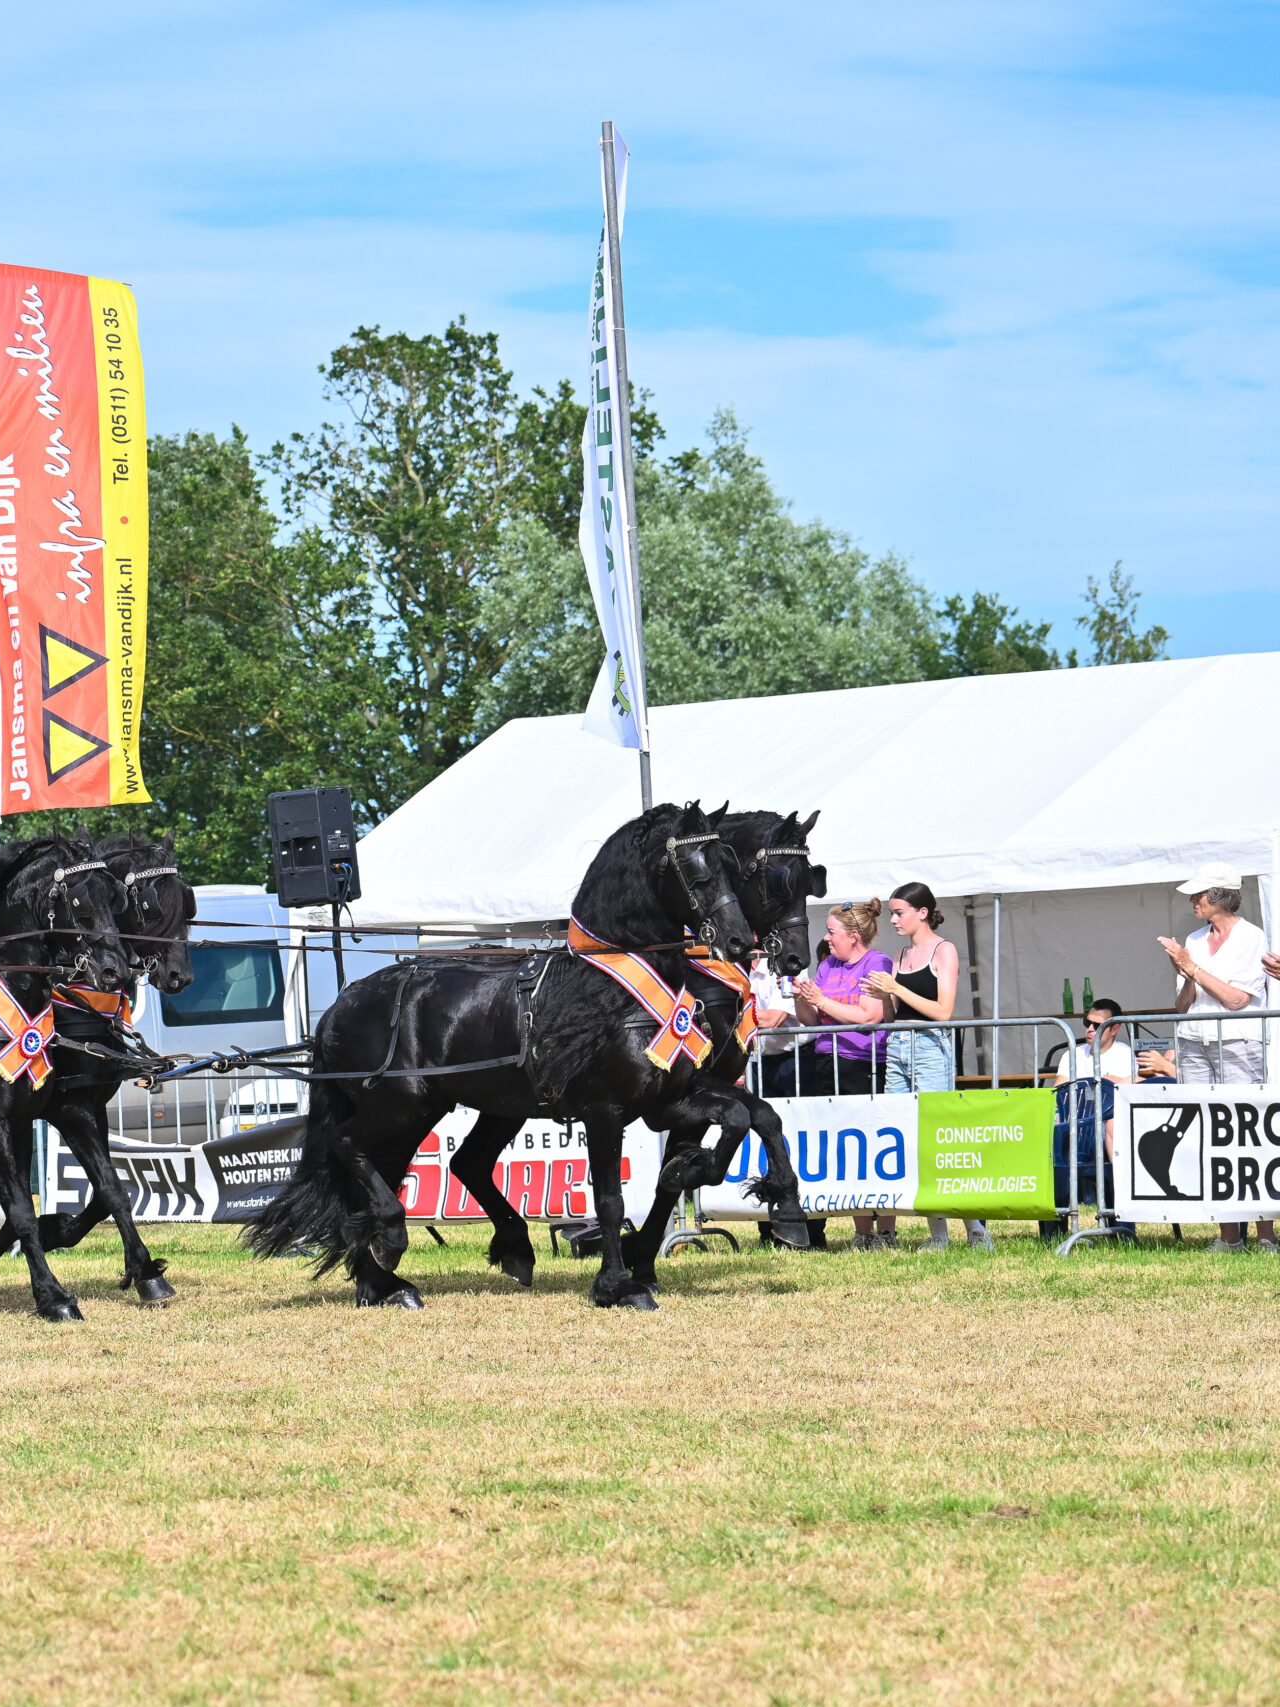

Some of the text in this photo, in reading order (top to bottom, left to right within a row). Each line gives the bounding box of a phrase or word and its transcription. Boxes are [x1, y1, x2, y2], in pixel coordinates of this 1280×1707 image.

[102, 307, 120, 329] 35
[106, 333, 122, 351] 10
[108, 359, 125, 381] 54
[109, 387, 132, 445] (0511)
[5, 284, 107, 604] infra en milieu
[112, 453, 130, 485] Tel.
[9, 659, 32, 801] Jansma
[936, 1125, 1024, 1145] CONNECTING
[218, 1147, 303, 1168] MAATWERK IN
[935, 1152, 982, 1170] GREEN
[56, 1152, 205, 1216] SARK
[222, 1166, 294, 1185] HOUTEN STA
[399, 1131, 631, 1219] SWAR
[935, 1176, 1038, 1195] TECHNOLOGIES
